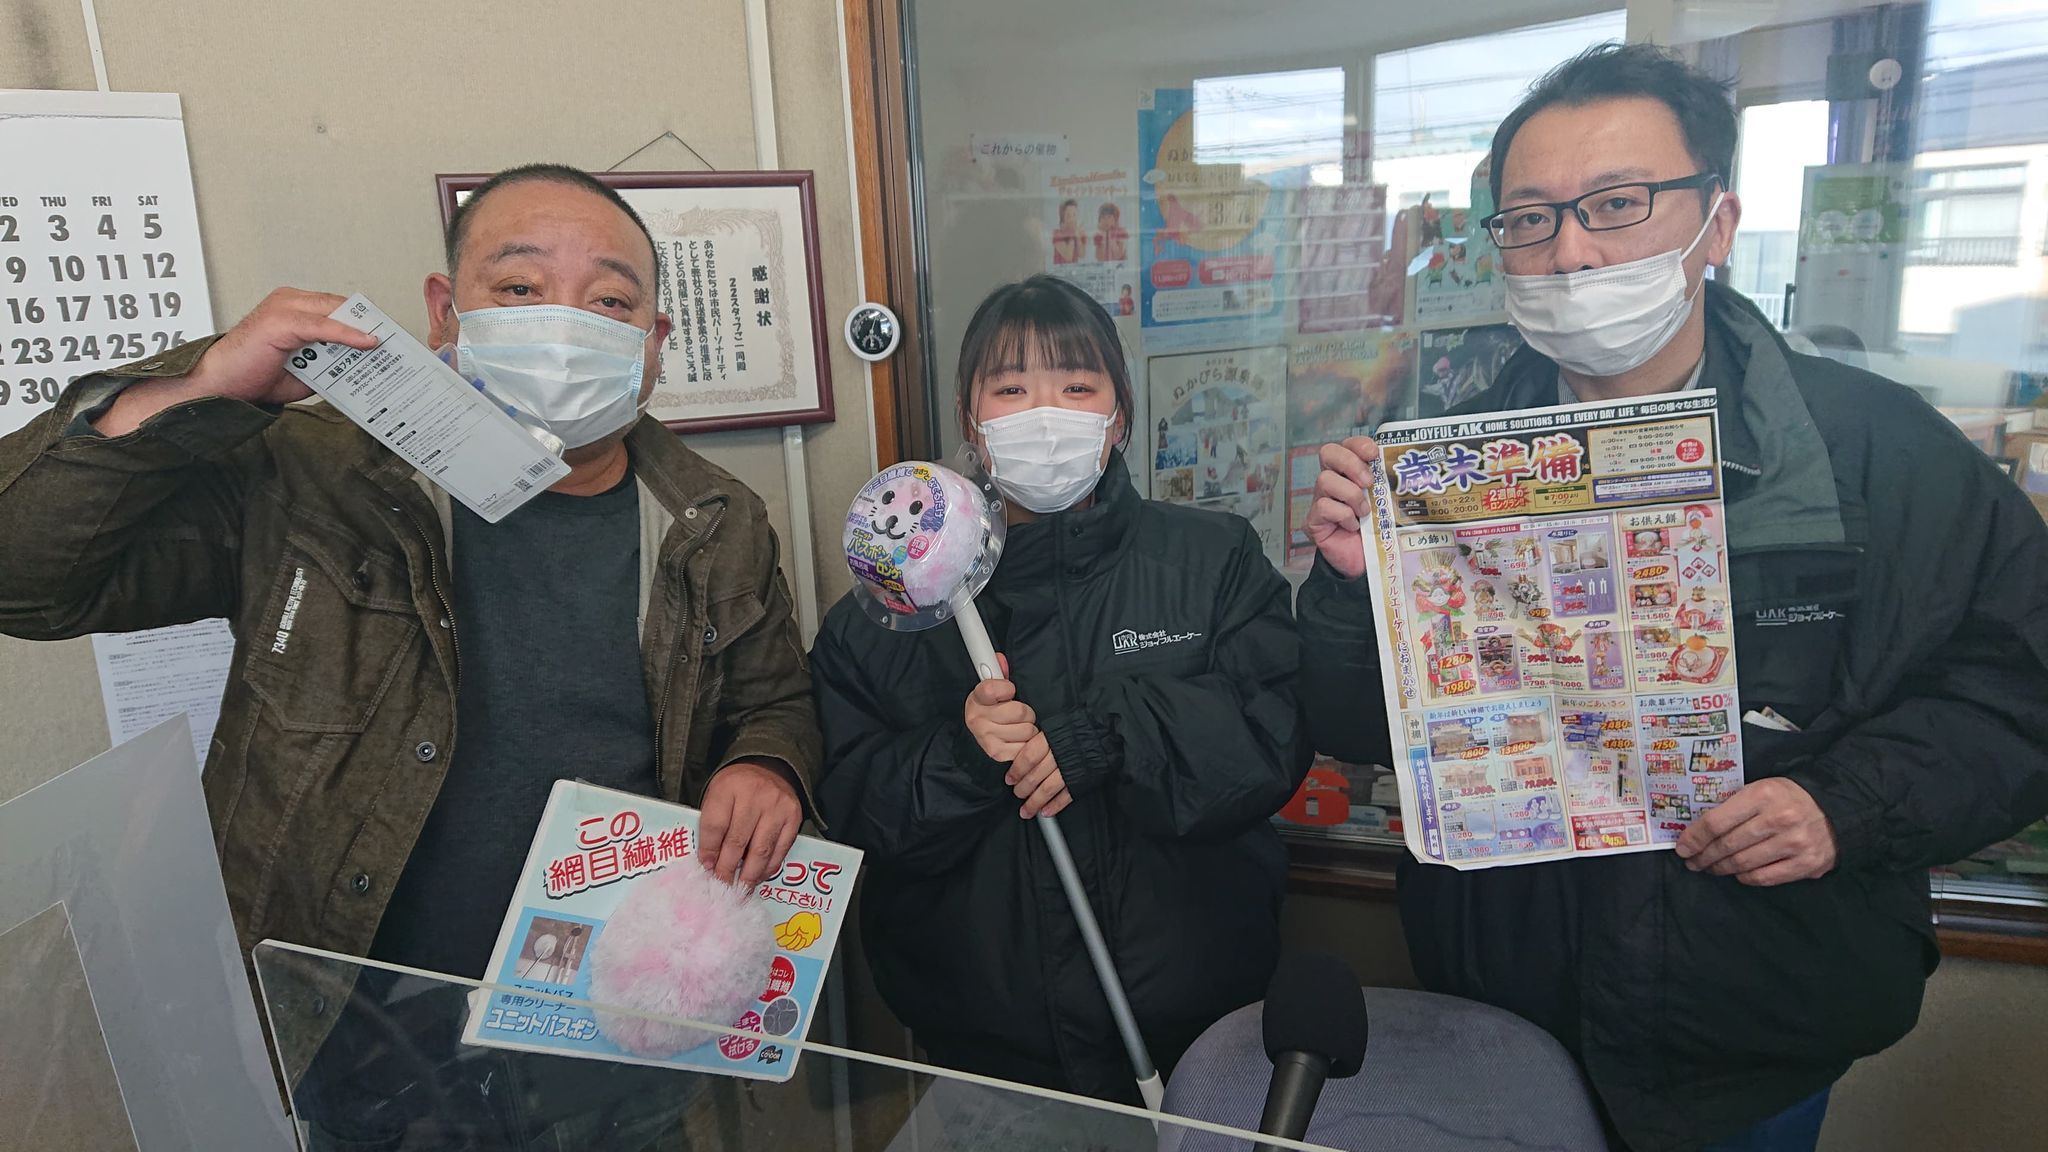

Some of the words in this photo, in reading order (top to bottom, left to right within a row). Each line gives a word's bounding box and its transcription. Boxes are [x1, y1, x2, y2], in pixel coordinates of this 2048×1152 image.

[0, 196, 18, 206] ED
[40, 196, 67, 207] THU
[92, 196, 112, 206] FRI
[138, 195, 158, 206] SAT
[0, 215, 20, 241] 2
[48, 215, 69, 241] 3
[97, 214, 117, 240] 4
[143, 213, 162, 239] 5
[6, 257, 26, 283] 9
[48, 256, 85, 281] 10
[96, 254, 128, 280] 11
[142, 253, 176, 278] 12
[6, 298, 45, 323] 16
[56, 296, 91, 321] 17
[103, 294, 138, 319] 18
[149, 292, 181, 317] 19
[752, 265, 772, 327] 感謝状
[11, 338, 54, 364] 23
[60, 336, 100, 361] 24
[106, 334, 146, 359] 25
[19, 378, 60, 404] 30
[1411, 422, 1485, 442] JOYFUL-AK
[1486, 422, 1508, 433] HOME
[1510, 416, 1553, 430] SOLUTIONS
[1556, 412, 1572, 424] FOR
[1574, 410, 1598, 423] EVERY
[1600, 409, 1616, 420] DAY
[1618, 407, 1635, 417] LIFE
[1395, 436, 1583, 494] 歳末準備
[1489, 488, 1524, 500] 2週間の
[1630, 512, 1678, 527] お供え餅
[1408, 535, 1449, 547] しめ飾り
[272, 631, 289, 655] 7340
[1138, 630, 1167, 641] 株式会社
[1140, 631, 1202, 649] ジョイフルエーケー
[1640, 697, 1692, 708] お歳暮ギフト
[578, 810, 641, 846] この
[548, 826, 692, 892] 網目繊維
[758, 883, 834, 912] みて下さい!
[501, 994, 577, 1012] 専用クリーナー
[727, 1039, 755, 1058] 拭ける
